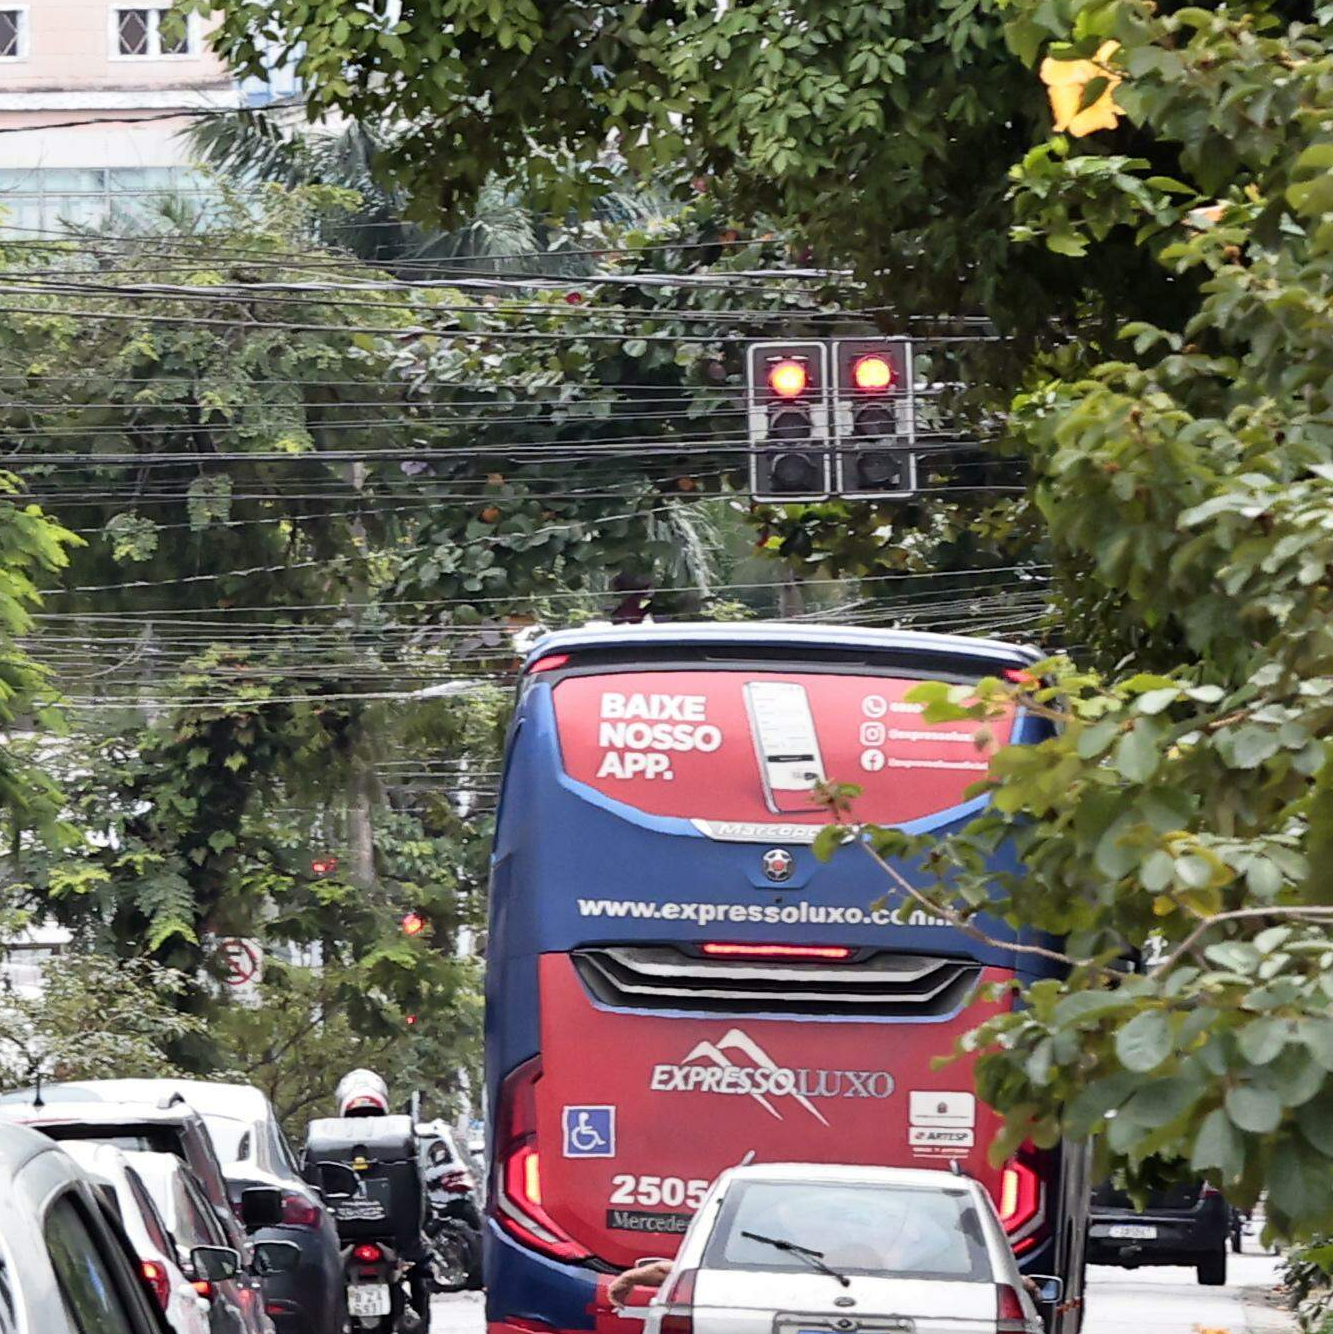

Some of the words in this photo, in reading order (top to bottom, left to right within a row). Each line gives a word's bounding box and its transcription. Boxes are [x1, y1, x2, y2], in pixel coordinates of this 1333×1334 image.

[600, 692, 707, 721] BAIXE
[598, 722, 723, 752] NOSSO
[595, 751, 674, 781] APP.
[719, 823, 820, 838] Marcopo
[576, 897, 977, 927] www.expressoluxo.com.
[650, 1064, 797, 1096] EXPRESSO
[797, 1068, 895, 1098] LUXO
[609, 1174, 709, 1209] 2505
[613, 1211, 688, 1232] Mercede
